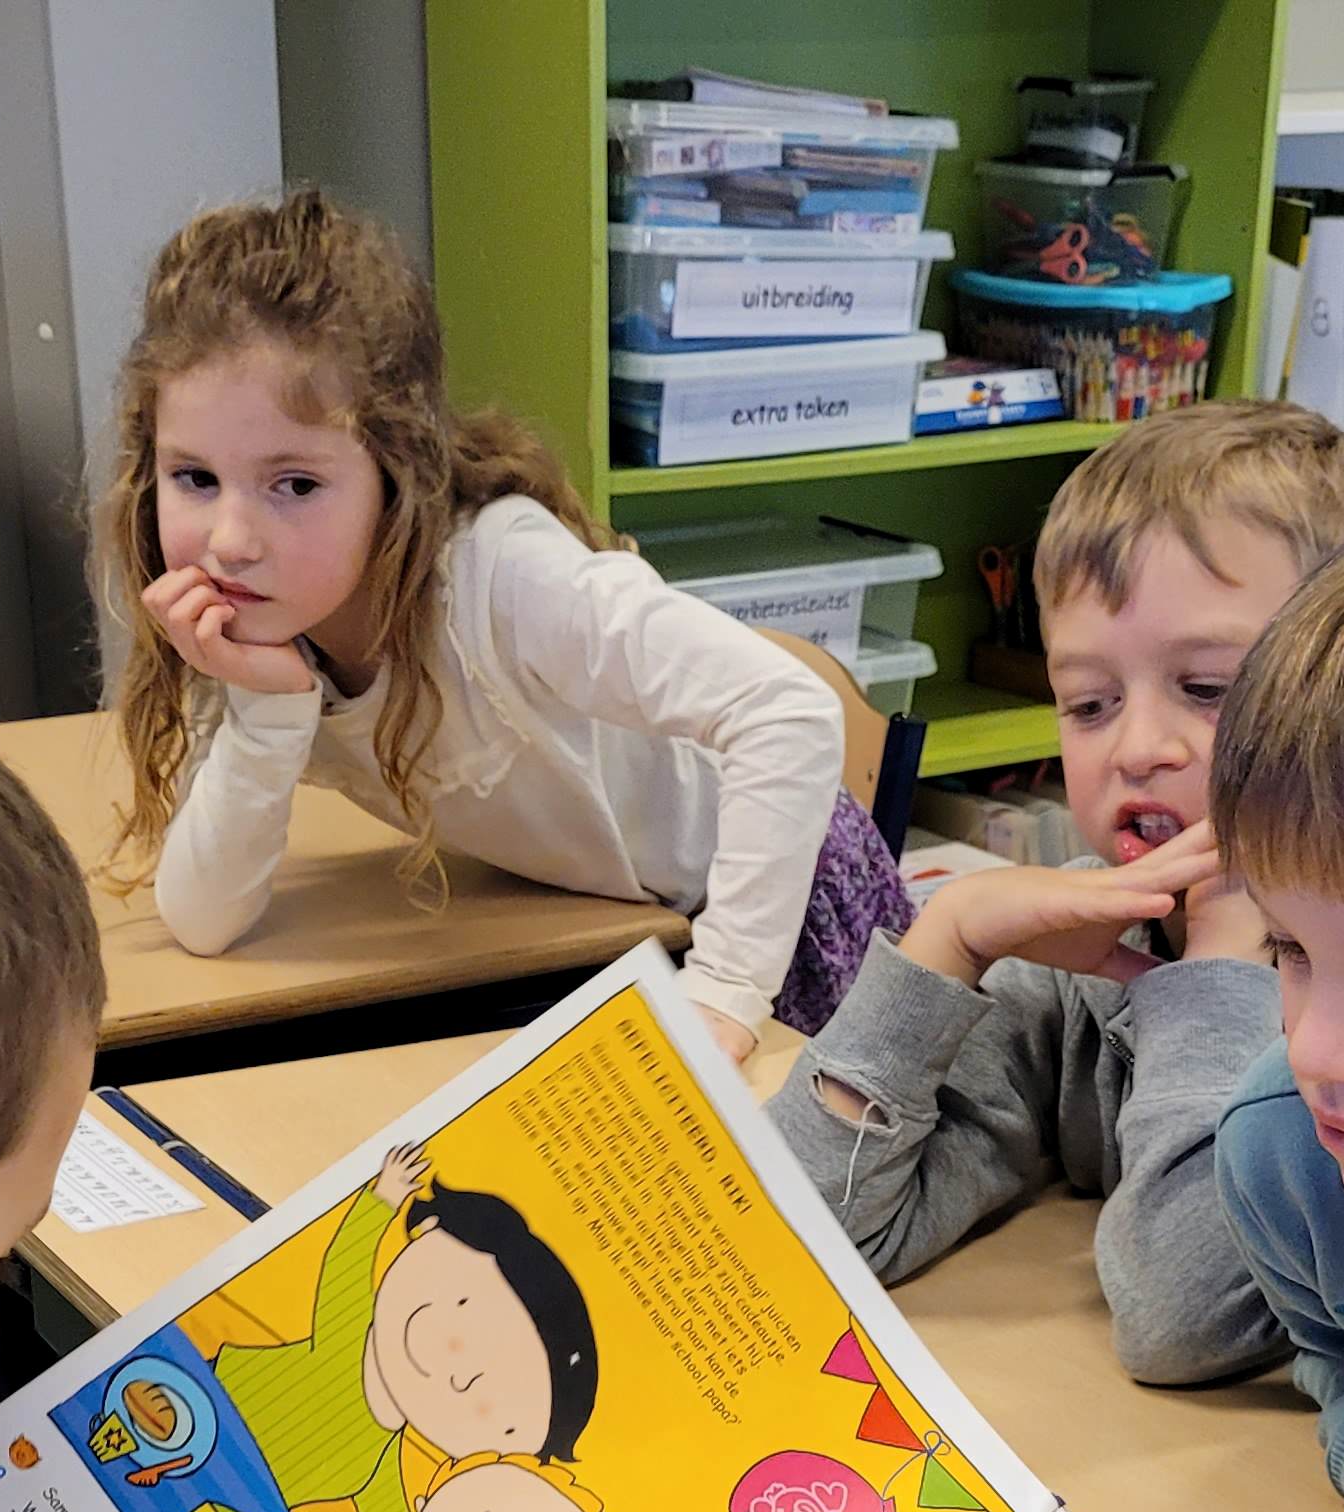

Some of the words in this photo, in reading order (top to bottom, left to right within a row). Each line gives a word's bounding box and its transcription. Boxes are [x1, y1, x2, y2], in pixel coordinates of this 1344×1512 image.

[741, 285, 854, 315] uitbreiding
[731, 402, 787, 426] extra
[796, 396, 848, 420] taken
[648, 1308, 675, 1338] naar
[681, 1287, 707, 1316] deur
[703, 1319, 728, 1346] met
[724, 1346, 747, 1375] iets
[698, 1282, 749, 1343] probeert
[759, 1302, 801, 1353] juichen
[680, 1317, 708, 1351] Daar
[703, 1351, 726, 1380] kan
[723, 1380, 739, 1399] de
